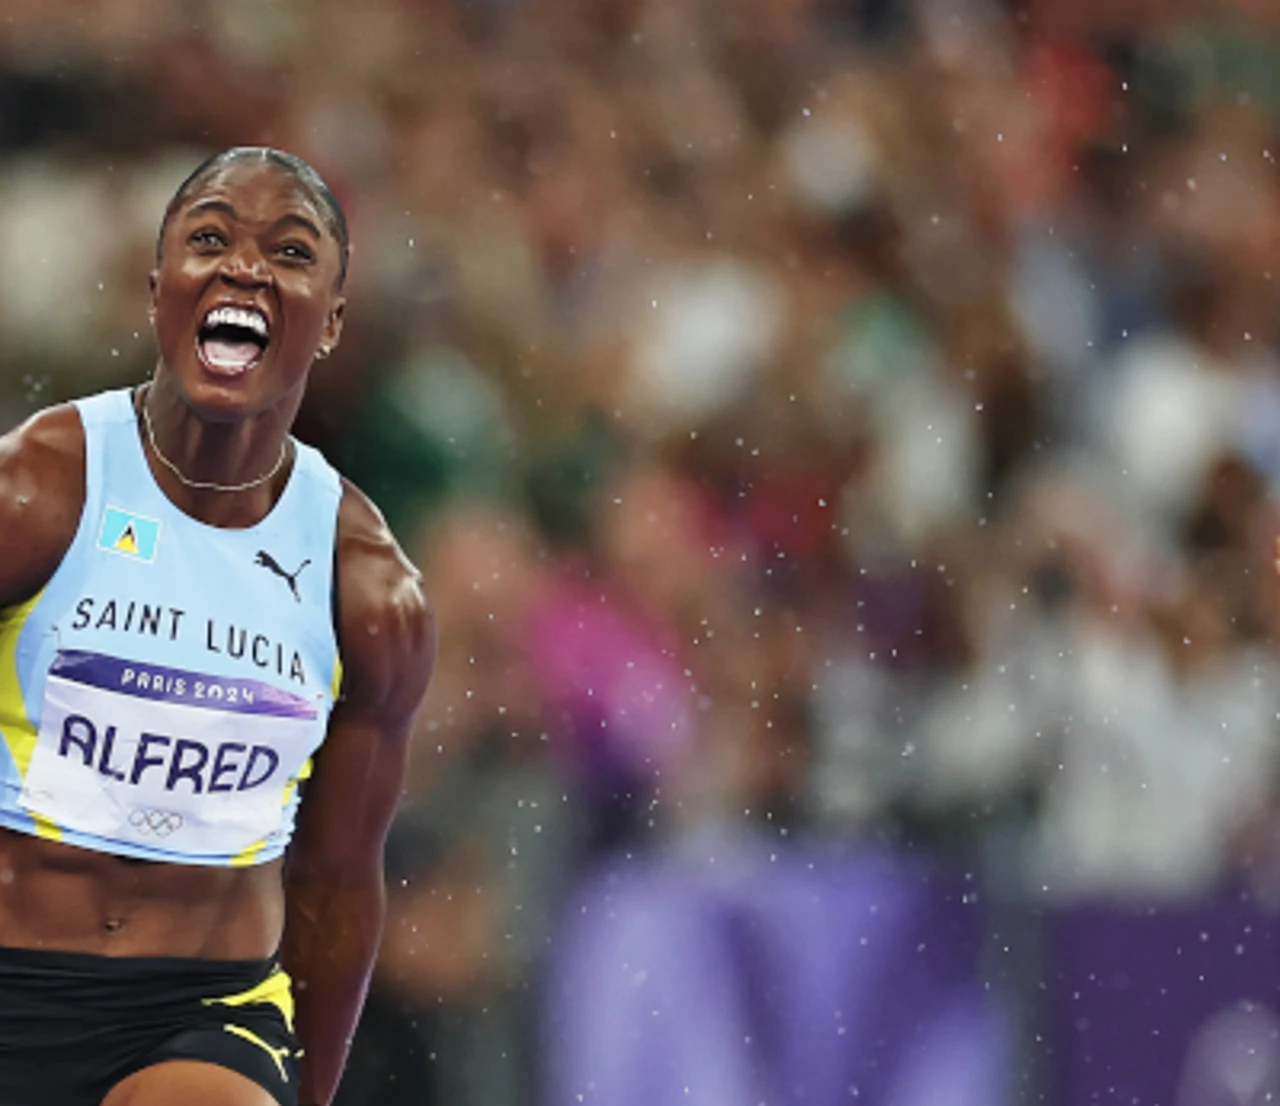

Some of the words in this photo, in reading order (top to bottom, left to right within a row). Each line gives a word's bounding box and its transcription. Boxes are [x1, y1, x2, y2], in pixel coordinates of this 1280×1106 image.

[72, 598, 185, 641] SAINT
[206, 619, 307, 685] LUCIA
[121, 667, 188, 698] PARIS
[193, 681, 256, 704] 2024
[57, 714, 280, 796] ALFRED
